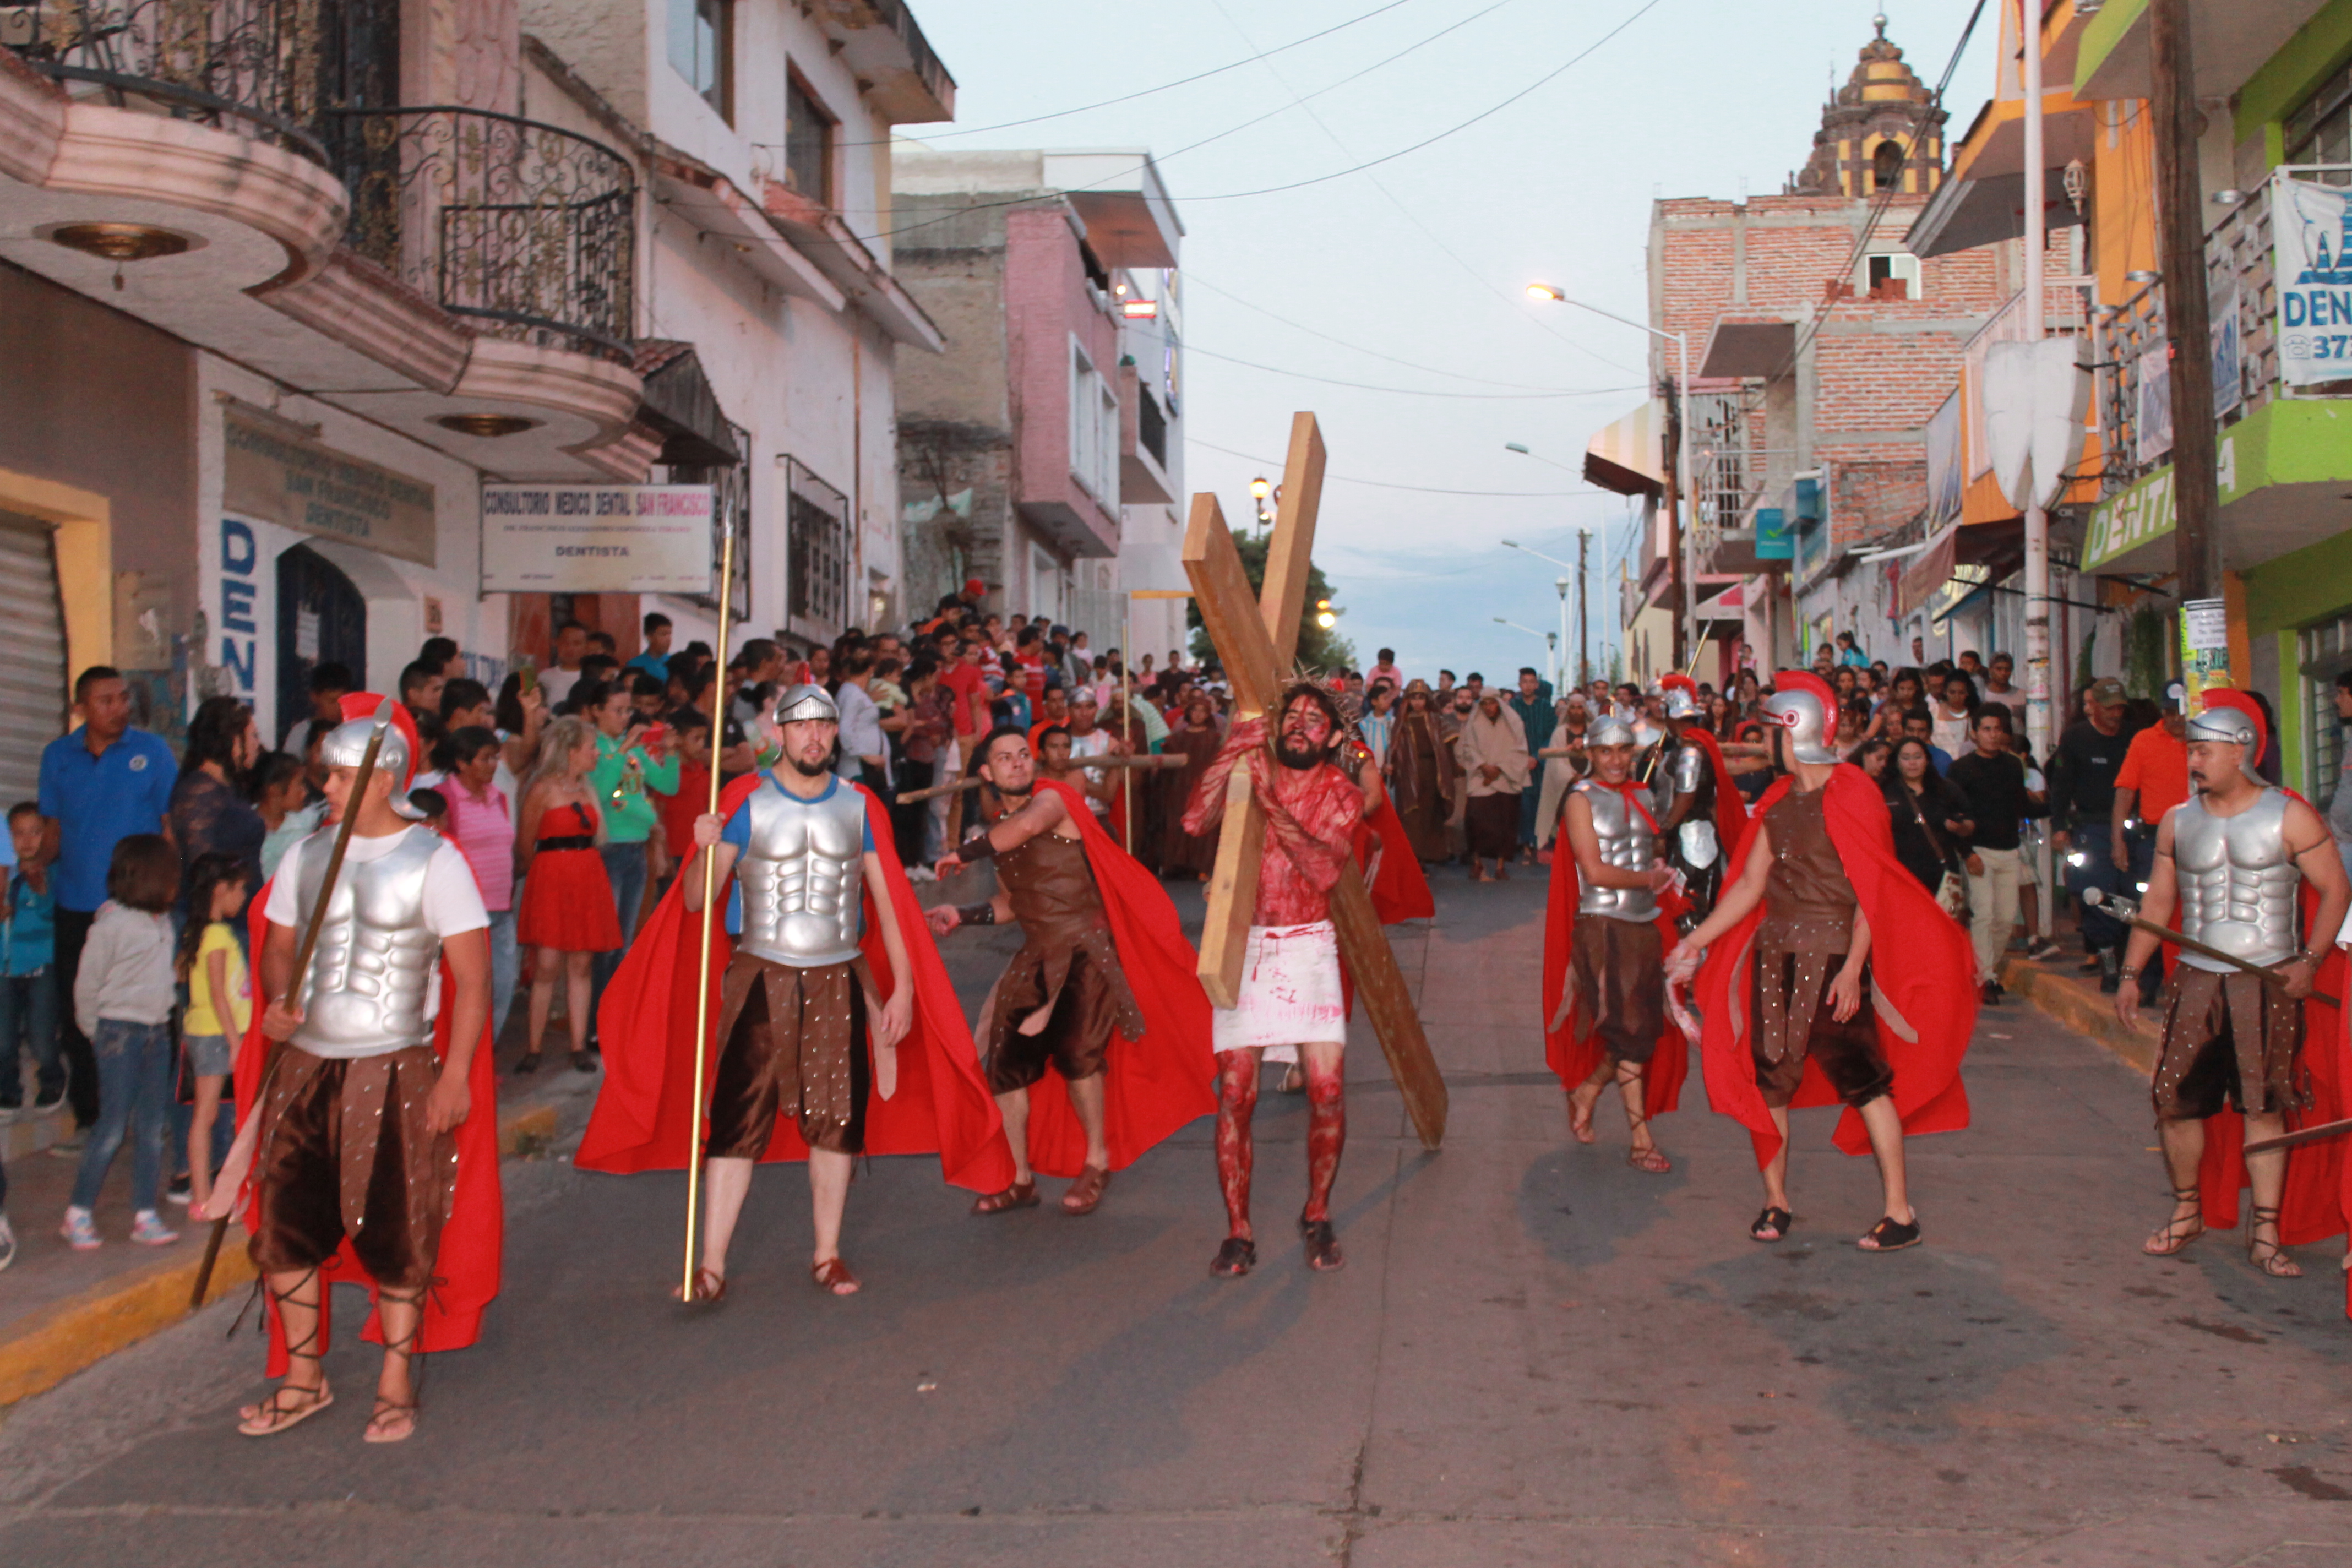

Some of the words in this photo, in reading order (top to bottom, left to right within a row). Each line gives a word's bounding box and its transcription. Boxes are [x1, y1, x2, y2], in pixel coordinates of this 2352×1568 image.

[2284, 291, 2352, 326] DEN
[2313, 335, 2352, 358] 37
[484, 491, 549, 516] CONSULTORIO
[554, 491, 591, 516] MEDICO
[595, 492, 632, 516] DENTAL
[636, 492, 656, 516] SAN
[658, 492, 710, 516] FRANCISCO
[2089, 436, 2236, 564] DENTIA
[305, 500, 370, 538] DENTISTA
[555, 545, 630, 557] DENTISTA
